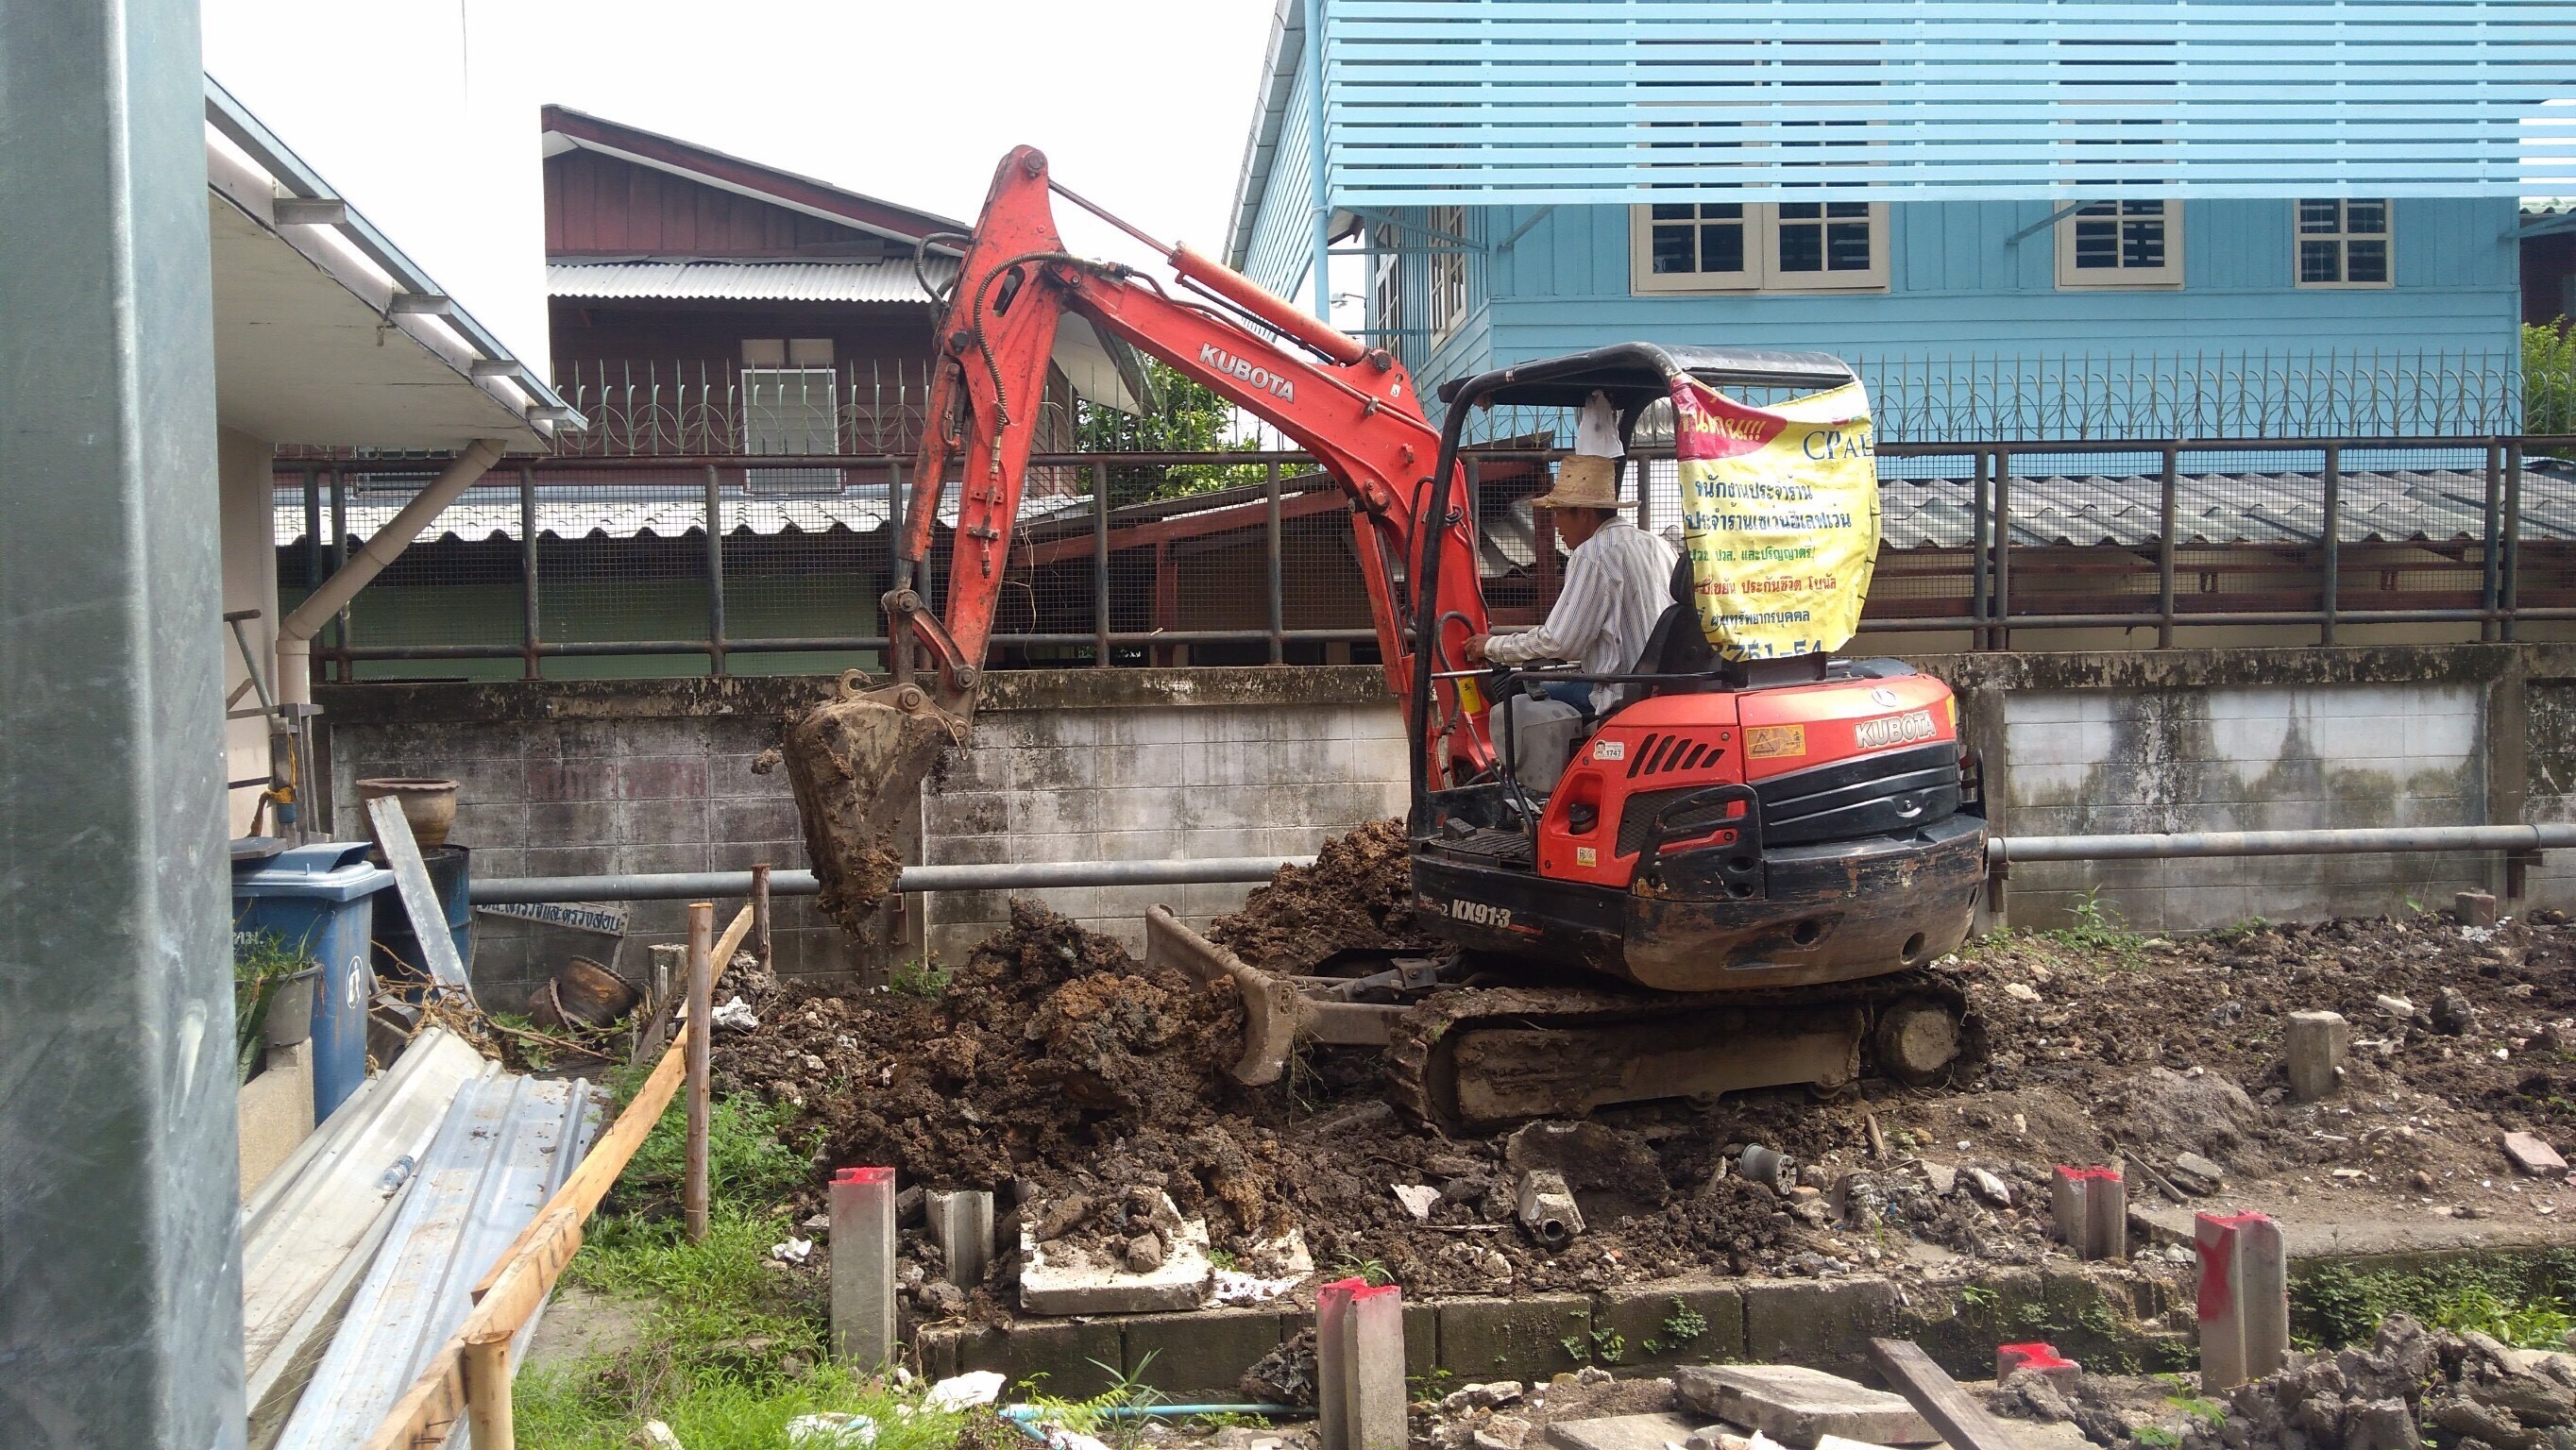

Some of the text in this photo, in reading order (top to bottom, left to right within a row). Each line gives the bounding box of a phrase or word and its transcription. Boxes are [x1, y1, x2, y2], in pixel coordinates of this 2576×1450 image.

[1198, 342, 1295, 404] KUBOTA
[1855, 711, 1936, 748] KUBOTA
[1451, 899, 1512, 928] KX91-3
